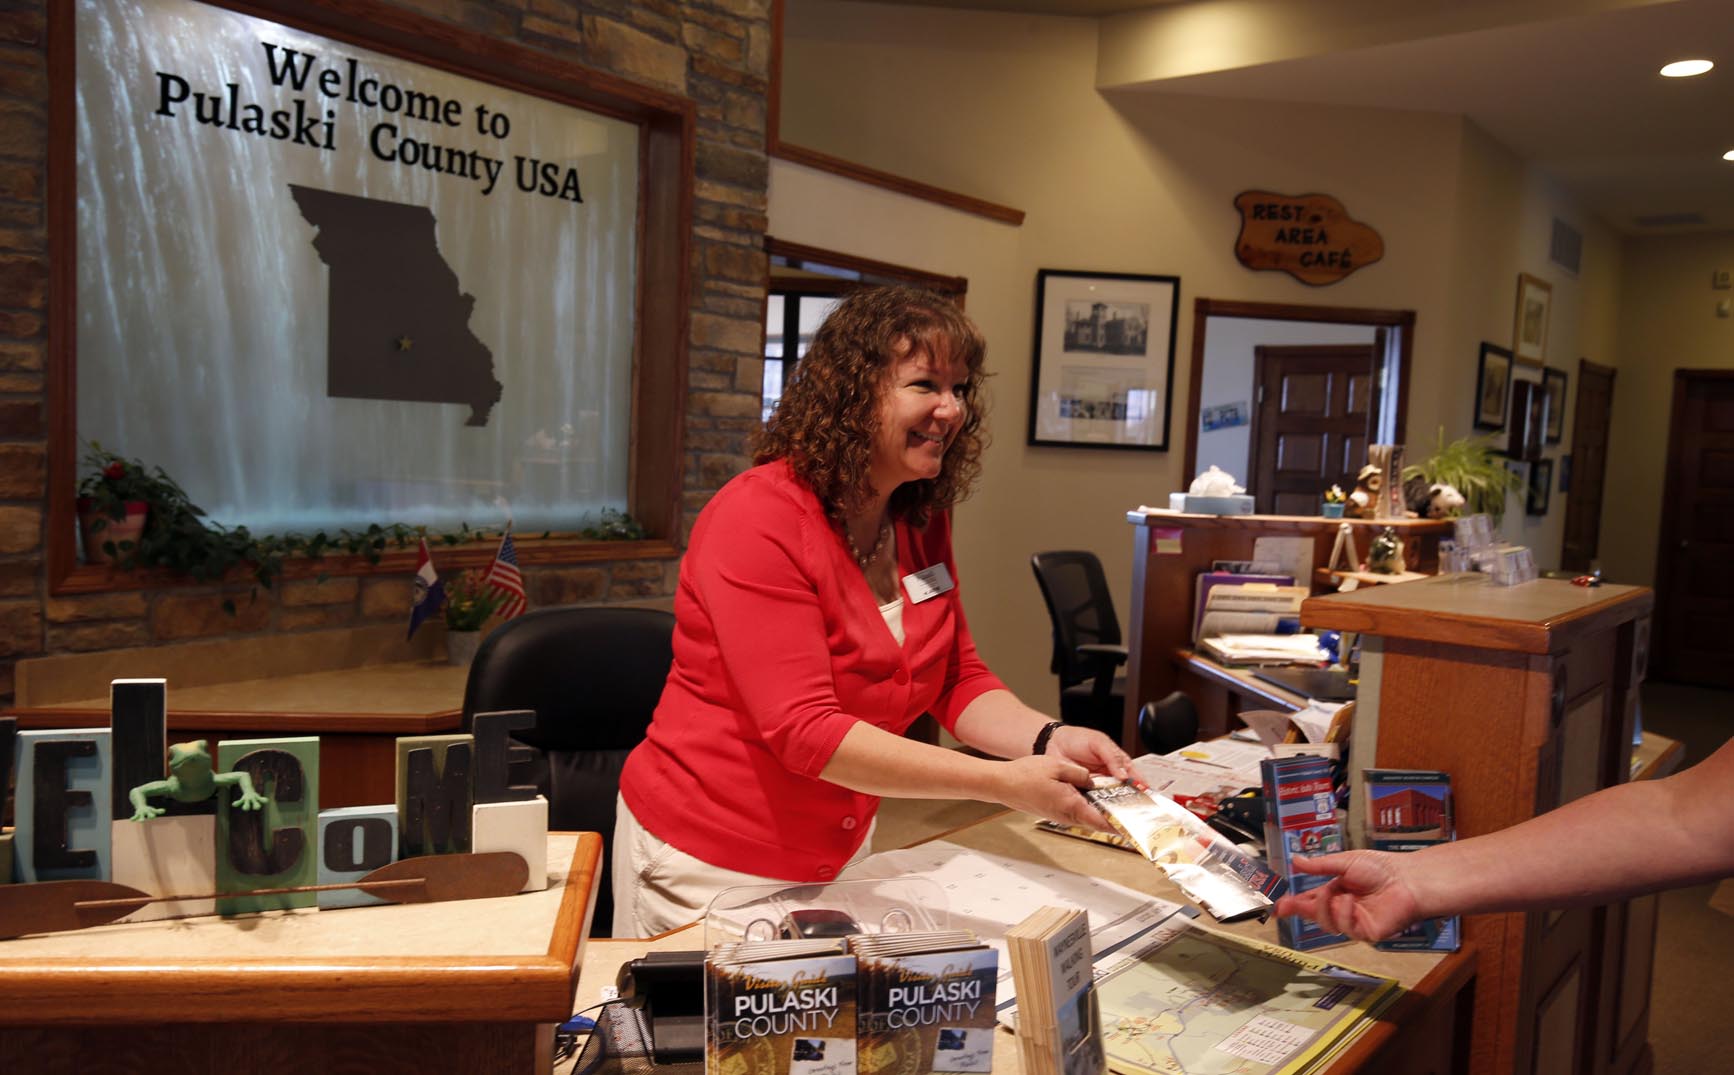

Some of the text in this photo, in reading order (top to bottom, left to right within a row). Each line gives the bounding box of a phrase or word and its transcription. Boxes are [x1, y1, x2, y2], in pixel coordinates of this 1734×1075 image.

[262, 42, 511, 139] Welcome to
[155, 71, 584, 204] Pulaski County USA
[1252, 203, 1305, 221] REST
[1274, 226, 1328, 245] AREA
[1299, 247, 1352, 269] CAFÉ
[734, 986, 838, 1017] PULASKI
[888, 979, 981, 1008] PULASKI
[734, 1008, 840, 1039] COUNTY
[887, 1000, 981, 1029] COUNTY
